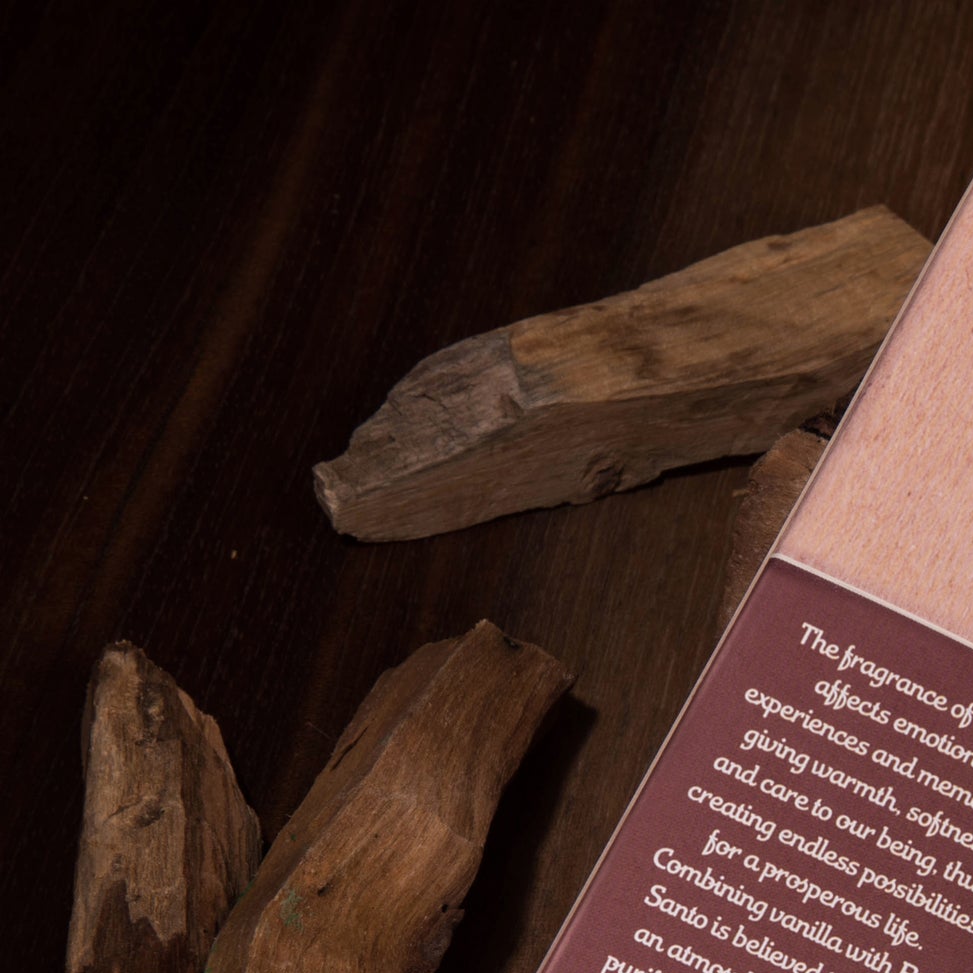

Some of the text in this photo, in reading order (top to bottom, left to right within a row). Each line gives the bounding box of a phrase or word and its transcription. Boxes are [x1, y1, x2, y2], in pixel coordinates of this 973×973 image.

[800, 622, 840, 660] The
[837, 644, 948, 712] fragrance
[814, 679, 891, 725] affects
[739, 729, 811, 774] giving
[811, 760, 901, 816] warmth,
[744, 688, 870, 756] experiences
[871, 749, 918, 779] and
[687, 786, 777, 842] creating
[778, 829, 860, 876] endless
[713, 756, 760, 787] and
[760, 778, 809, 811] care
[811, 798, 833, 821] to
[835, 814, 876, 840] our
[876, 826, 938, 877] being,
[644, 884, 709, 929] Santo
[710, 916, 732, 940] is
[653, 847, 769, 922] Combining
[769, 907, 843, 953] vanilla
[701, 829, 923, 951] for a prosperous life.
[633, 928, 665, 953] an
